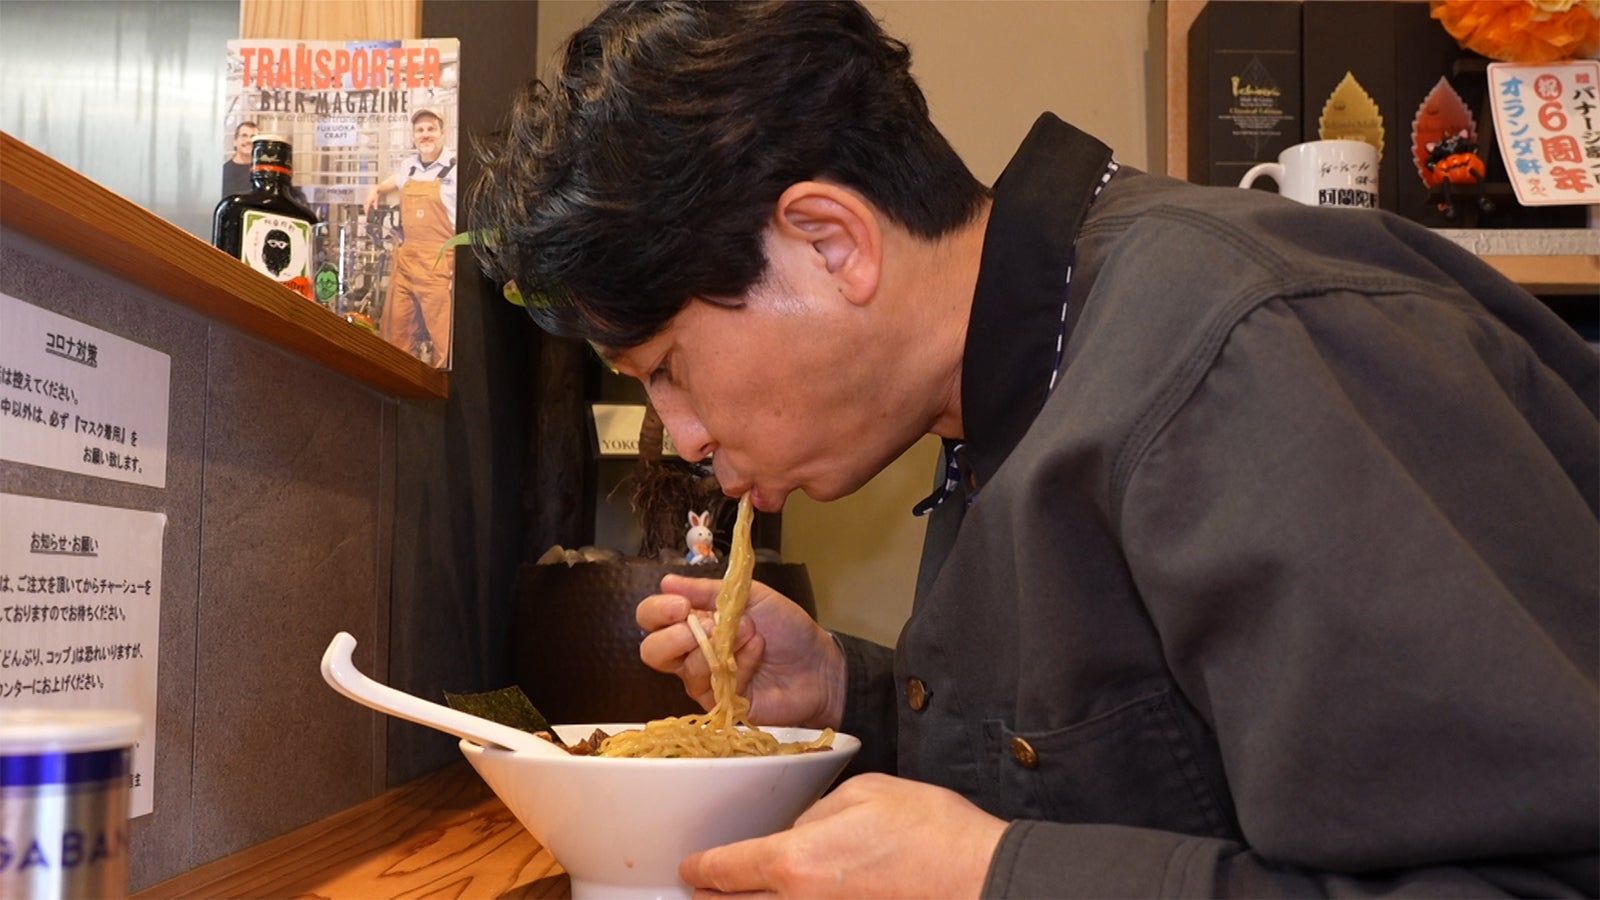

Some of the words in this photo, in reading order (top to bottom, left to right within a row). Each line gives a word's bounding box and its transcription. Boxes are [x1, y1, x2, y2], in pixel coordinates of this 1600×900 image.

[239, 47, 440, 89] TRANSPORTER
[260, 90, 306, 113] BEER
[315, 90, 409, 114] MAGAZINE
[46, 332, 98, 364] コロナ対策
[0, 366, 78, 406] は控えてください。
[83, 445, 143, 473] お願い致します。
[0, 642, 144, 669] どんぶり、コップ」は恐れいりますが、
